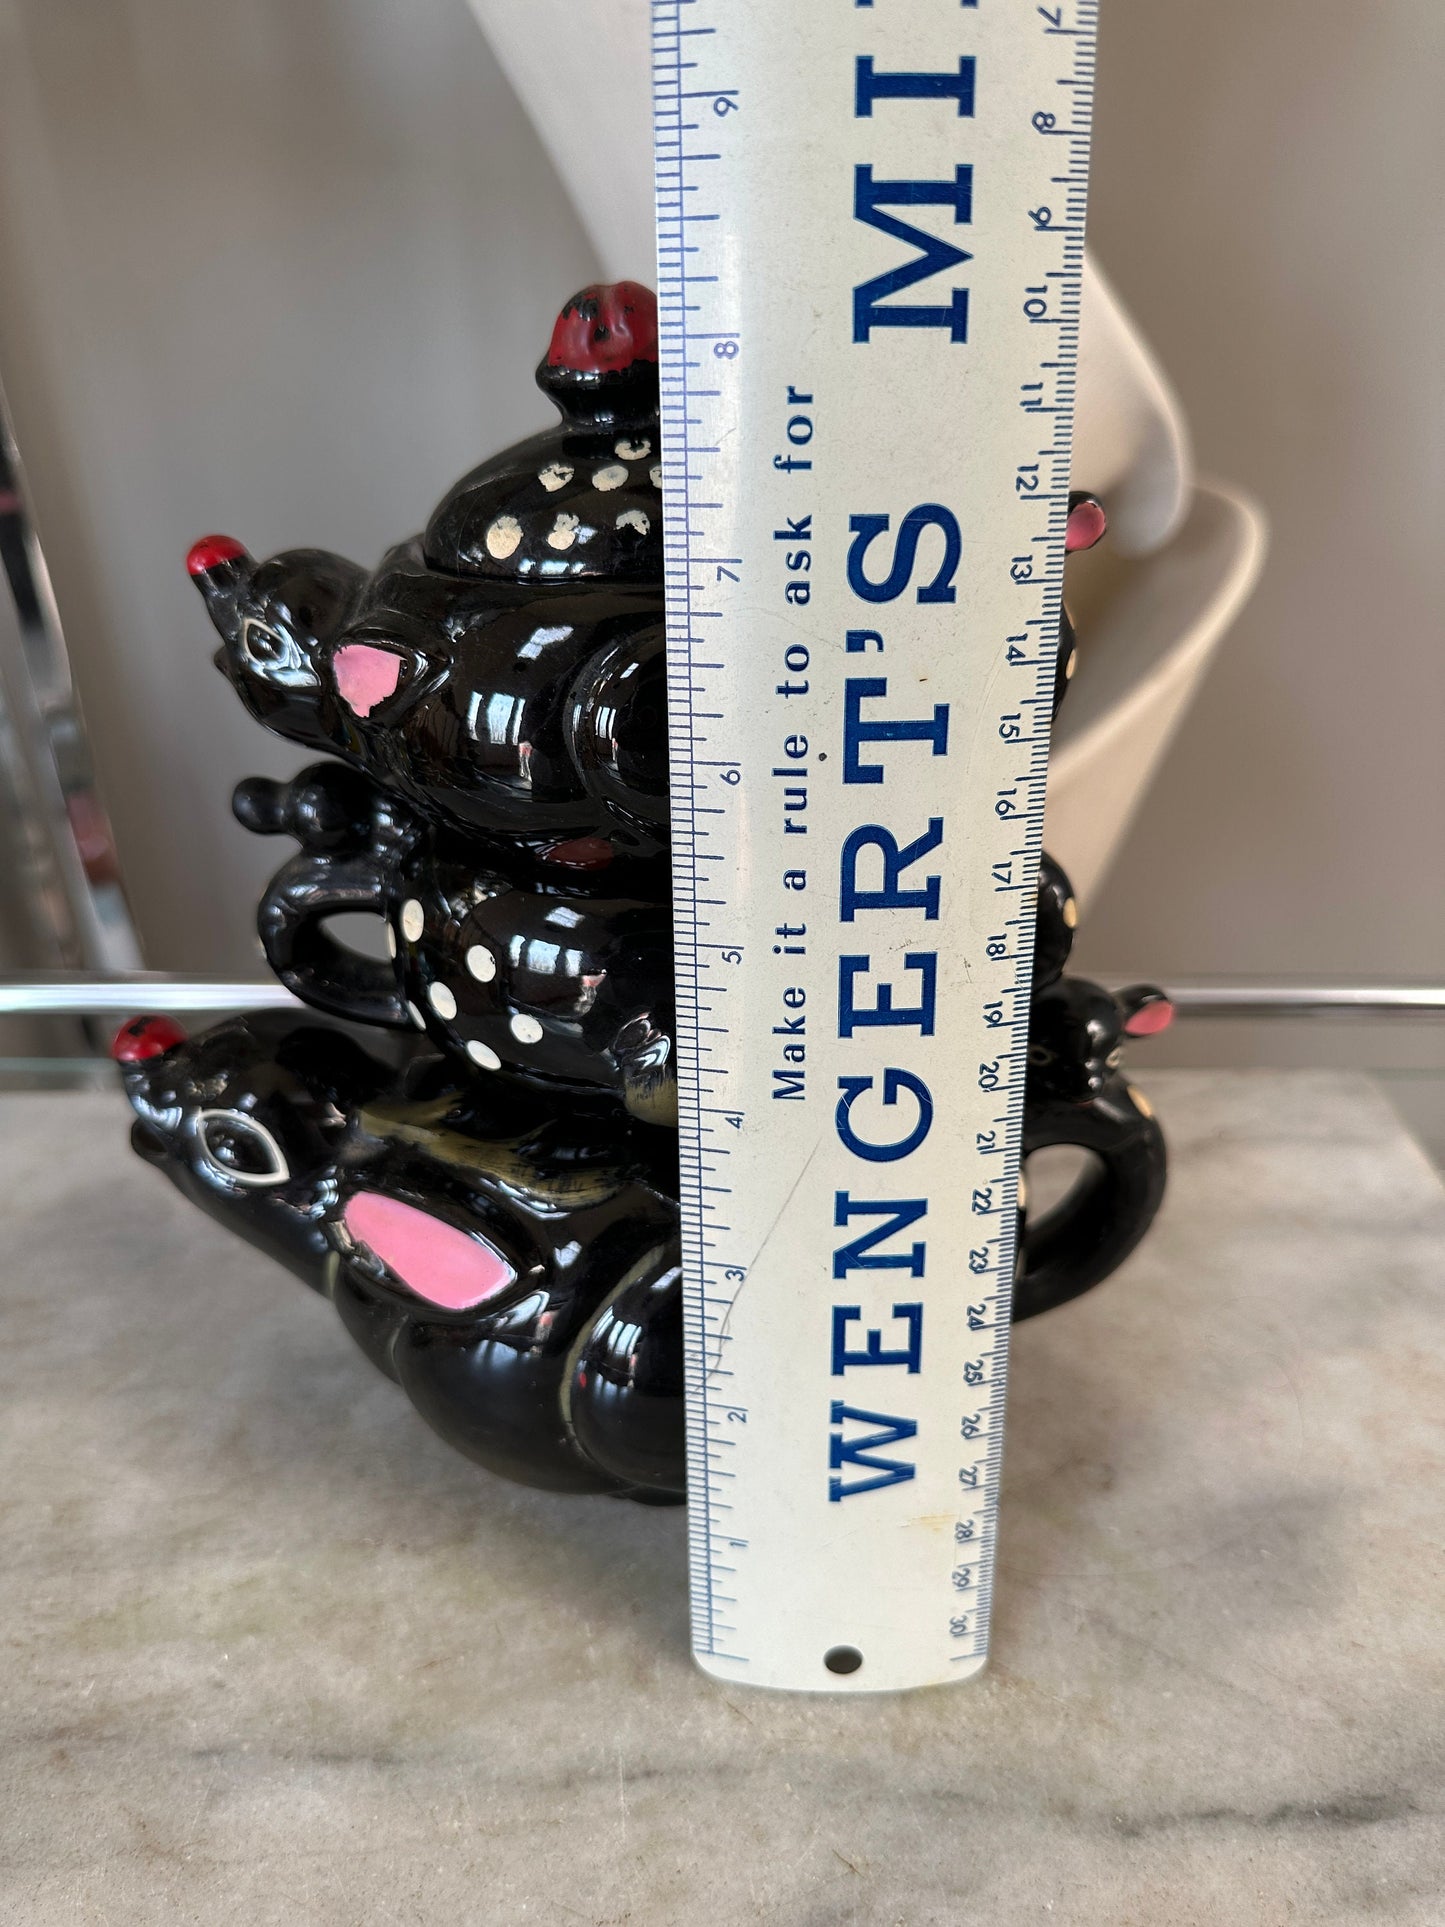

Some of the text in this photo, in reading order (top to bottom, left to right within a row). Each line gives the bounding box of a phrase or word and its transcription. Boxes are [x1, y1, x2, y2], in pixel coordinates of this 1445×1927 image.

[1037, 7, 1061, 25] 7
[713, 97, 739, 116] 9
[1032, 112, 1056, 131] 8
[1028, 207, 1052, 225] 9
[1023, 285, 1048, 318] 10
[714, 341, 739, 359] 8
[1021, 383, 1043, 406] 11
[1015, 464, 1039, 492] 12
[716, 566, 740, 582] 7
[1010, 555, 1033, 582] 13
[1005, 633, 1028, 660] 14
[999, 712, 1021, 738] 15
[772, 386, 813, 1100] Make it a rule to ask for
[829, 0, 977, 1502] WENGERT'S MI
[720, 770, 741, 785] 6
[995, 788, 1017, 815] 16
[992, 861, 1012, 886] 17
[722, 950, 743, 964] 5
[986, 934, 1007, 957] 18
[982, 1001, 1003, 1024] 19
[978, 1061, 1000, 1090] 20
[726, 1115, 743, 1129] 4
[976, 1130, 996, 1152] 21
[971, 1188, 992, 1215] 22
[968, 1246, 989, 1273] 23
[725, 1269, 744, 1282] 3
[966, 1303, 986, 1330] 24
[963, 1360, 984, 1385] 25
[728, 1411, 748, 1423] 2
[961, 1416, 981, 1438] 26
[959, 1467, 978, 1487] 27
[955, 1520, 974, 1543] 28
[952, 1569, 971, 1589] 29
[949, 1615, 967, 1637] 30
